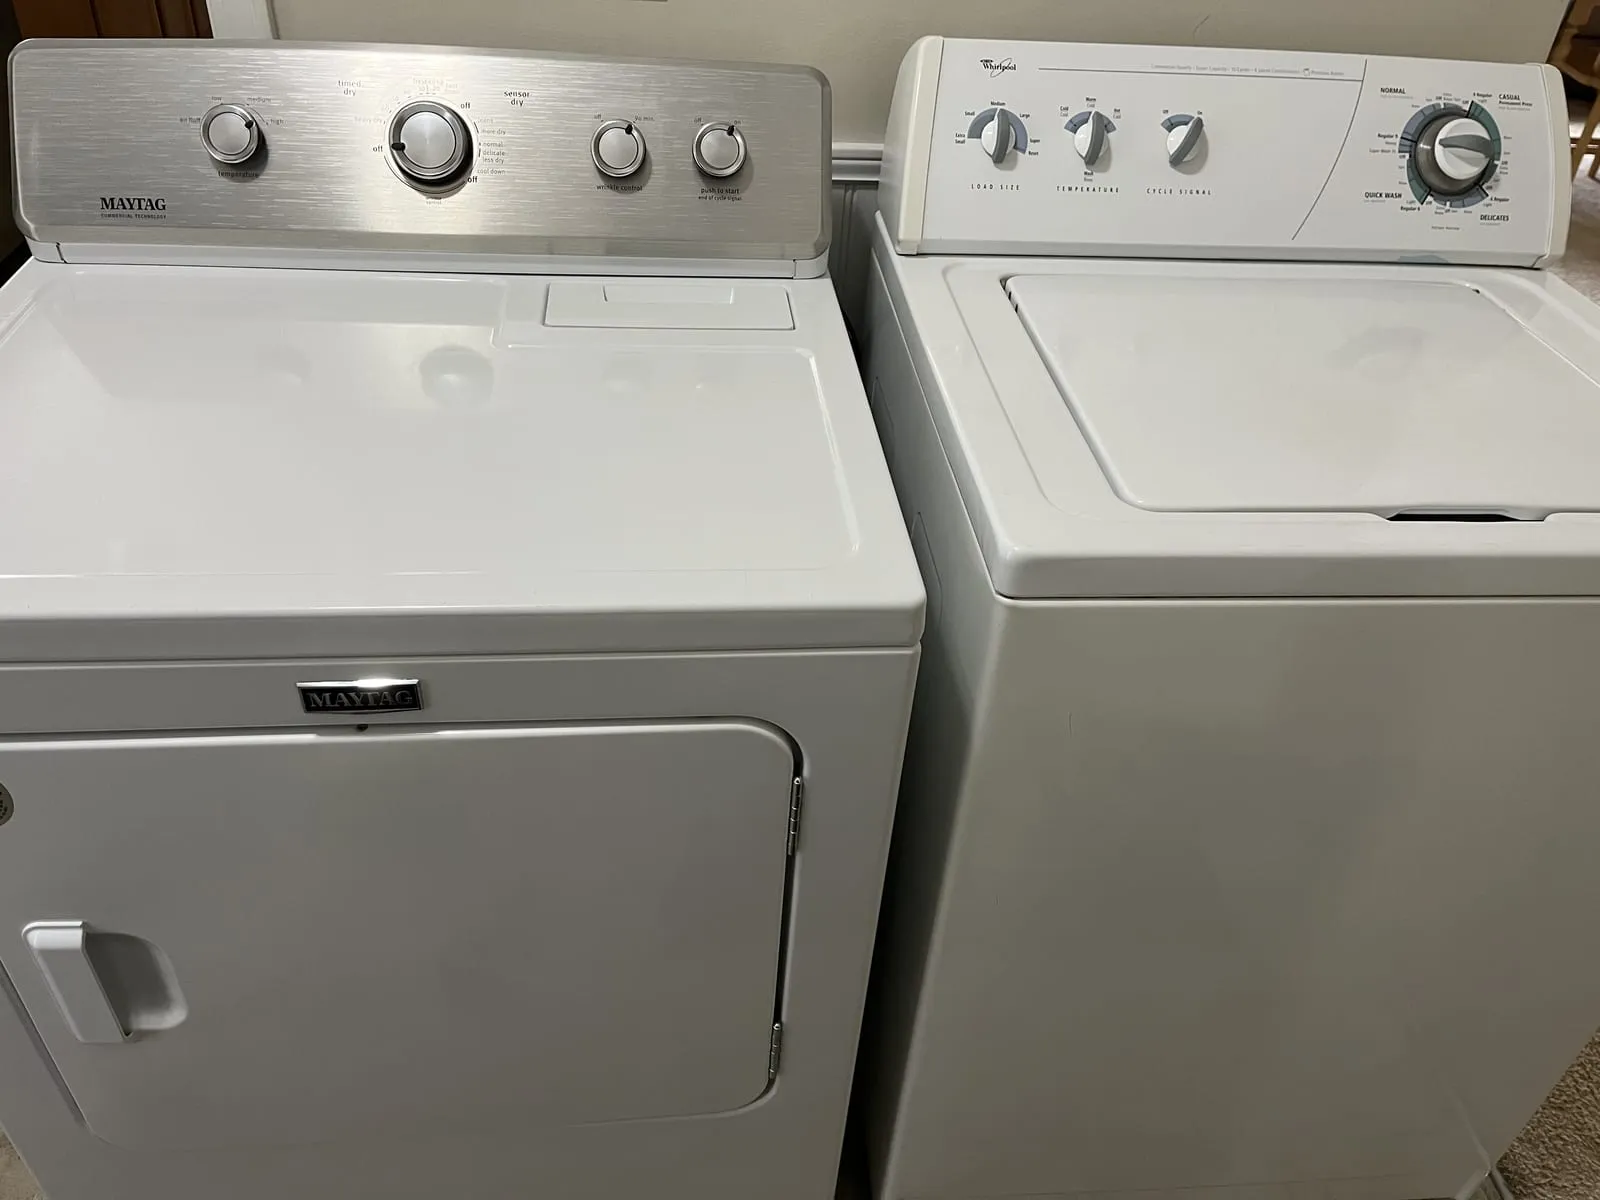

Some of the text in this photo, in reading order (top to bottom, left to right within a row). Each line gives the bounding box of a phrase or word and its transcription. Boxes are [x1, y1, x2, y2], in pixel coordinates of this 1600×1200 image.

[980, 58, 1016, 74] Whirlpool
[338, 80, 361, 88] timed
[343, 88, 356, 97] dry
[503, 90, 530, 98] sensor
[1380, 87, 1406, 95] NORMAL
[1498, 93, 1520, 101] CASUAL
[510, 98, 524, 107] dry
[218, 170, 259, 178] temperature
[467, 175, 478, 183] off
[1364, 191, 1384, 199] QUICK
[100, 197, 166, 210] MAYTAG
[1480, 214, 1509, 222] DELICATES
[305, 690, 413, 708] MAYTAG
